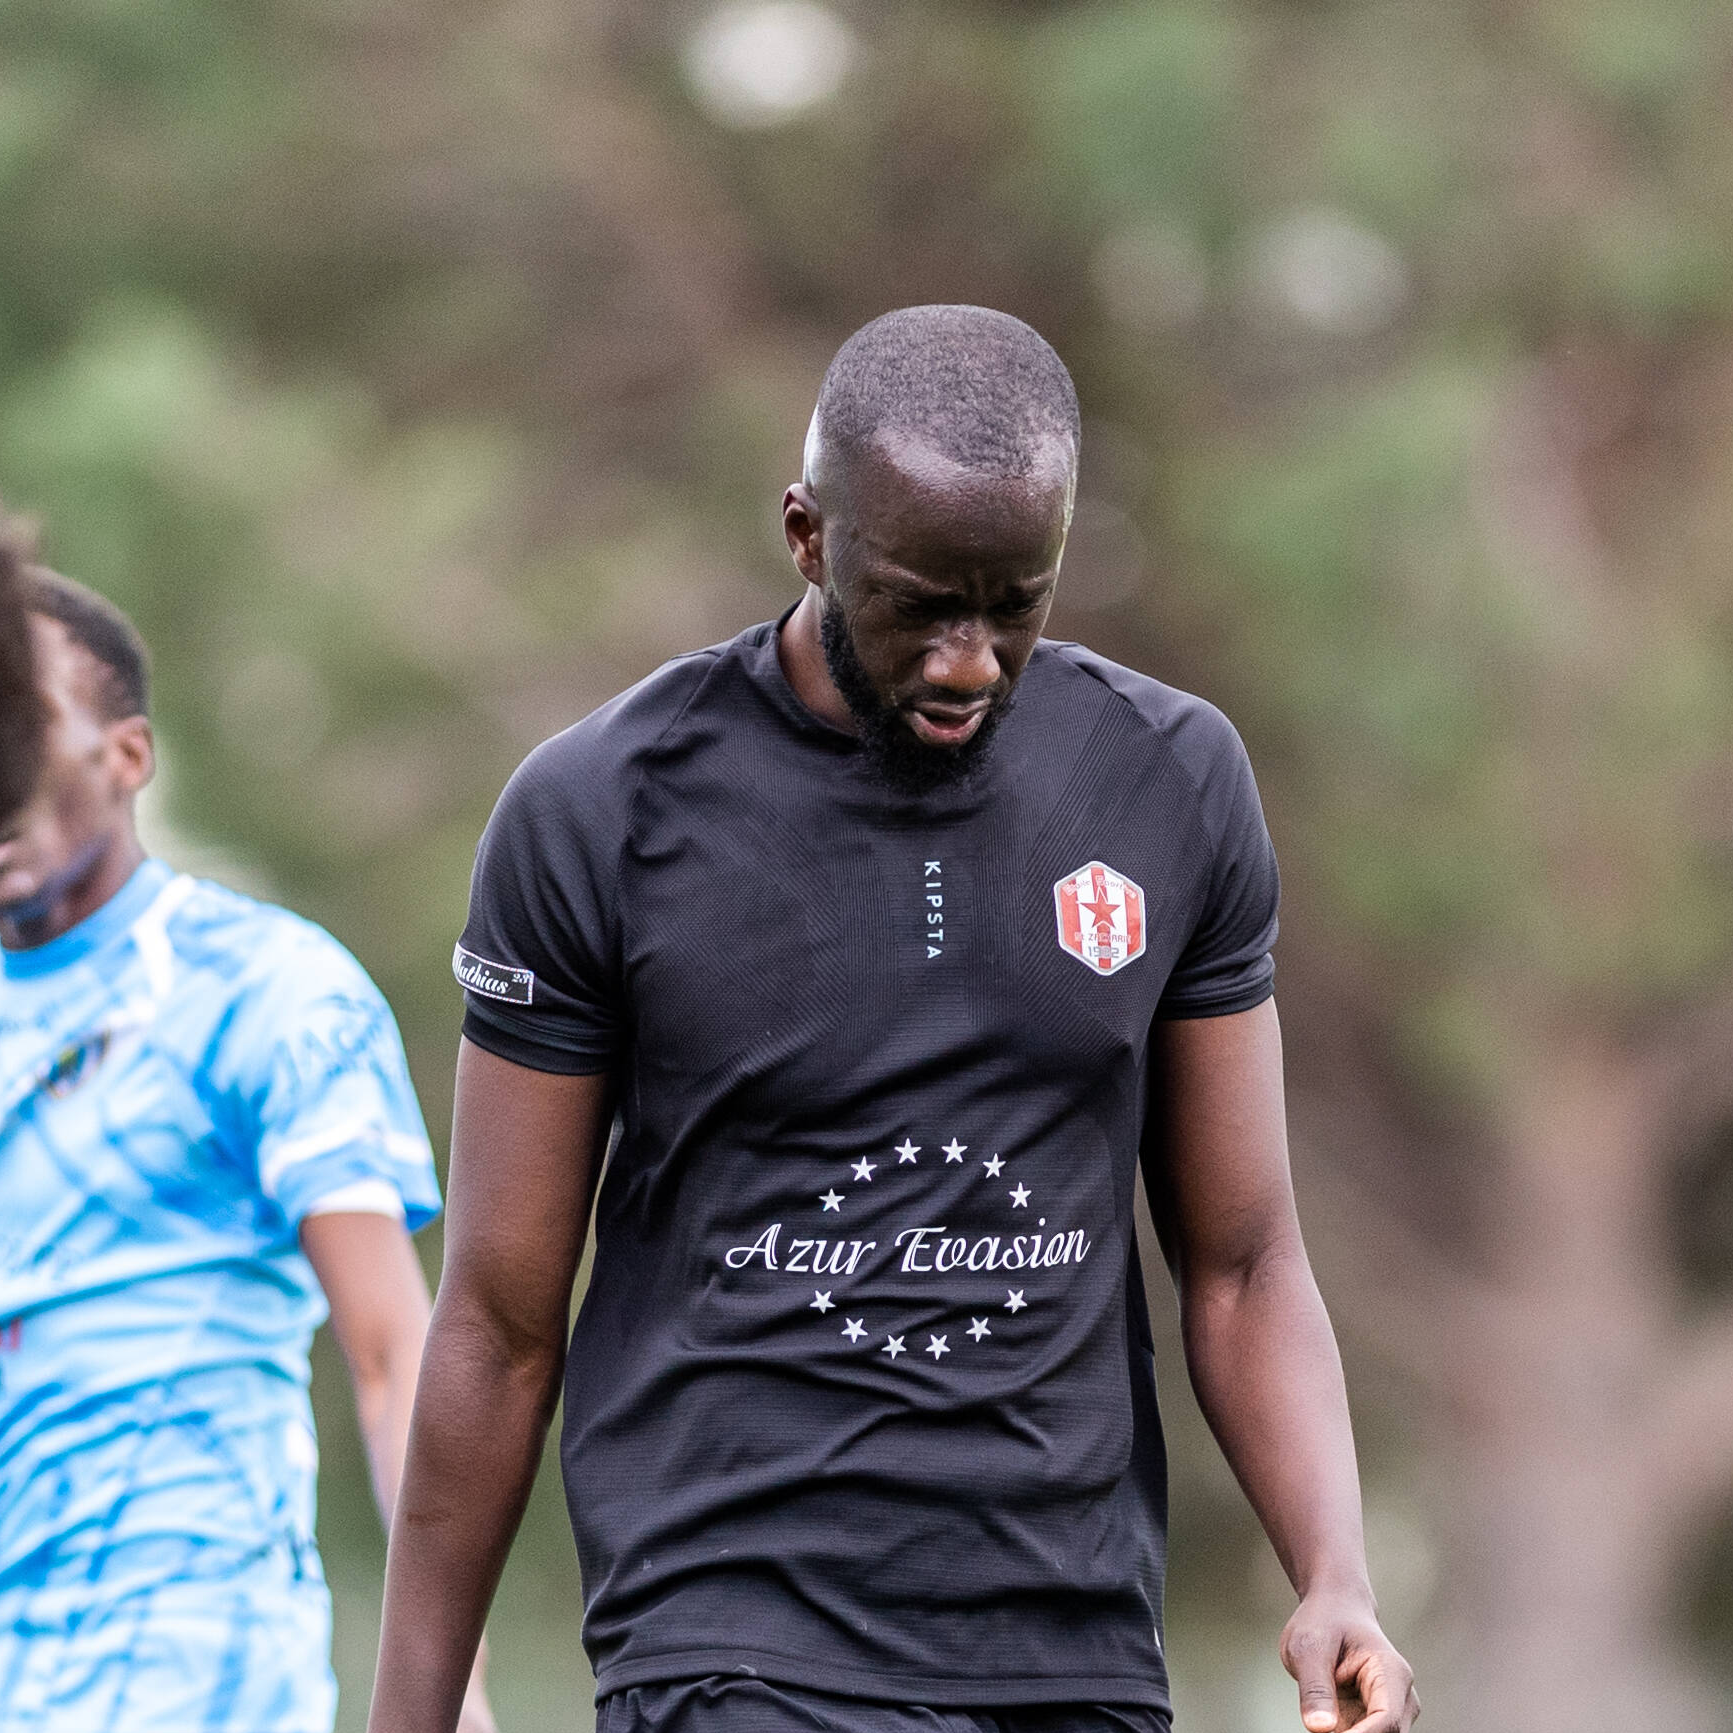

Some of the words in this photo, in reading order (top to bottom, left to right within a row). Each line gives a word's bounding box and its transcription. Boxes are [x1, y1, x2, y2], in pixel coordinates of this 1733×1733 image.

[924, 861, 944, 959] KIPSTA
[725, 1223, 877, 1275] Azur
[893, 1218, 1091, 1273] Evasion
